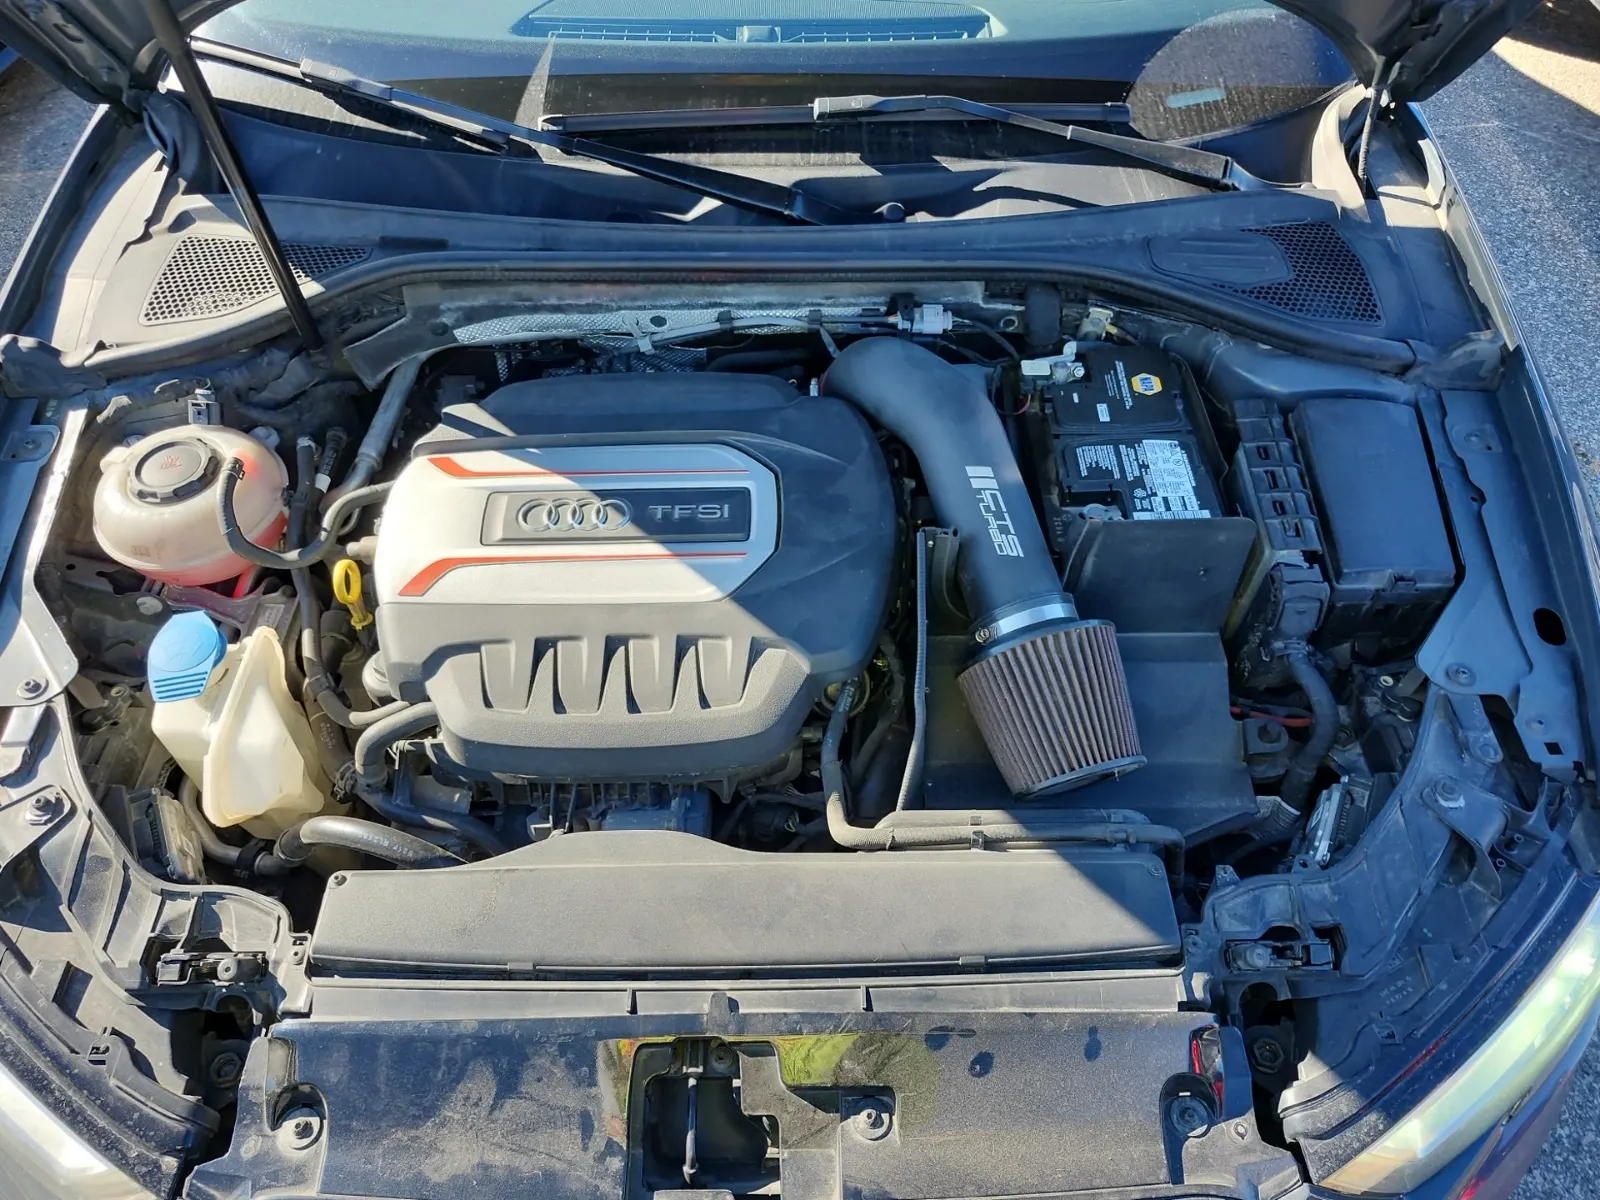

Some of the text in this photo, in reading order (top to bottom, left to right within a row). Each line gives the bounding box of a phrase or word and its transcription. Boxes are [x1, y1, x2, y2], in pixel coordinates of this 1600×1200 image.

[1139, 376, 1155, 393] NAPA
[648, 504, 730, 520] TFSI
[976, 489, 1008, 556] TURBO
[985, 489, 1024, 558] CTS
